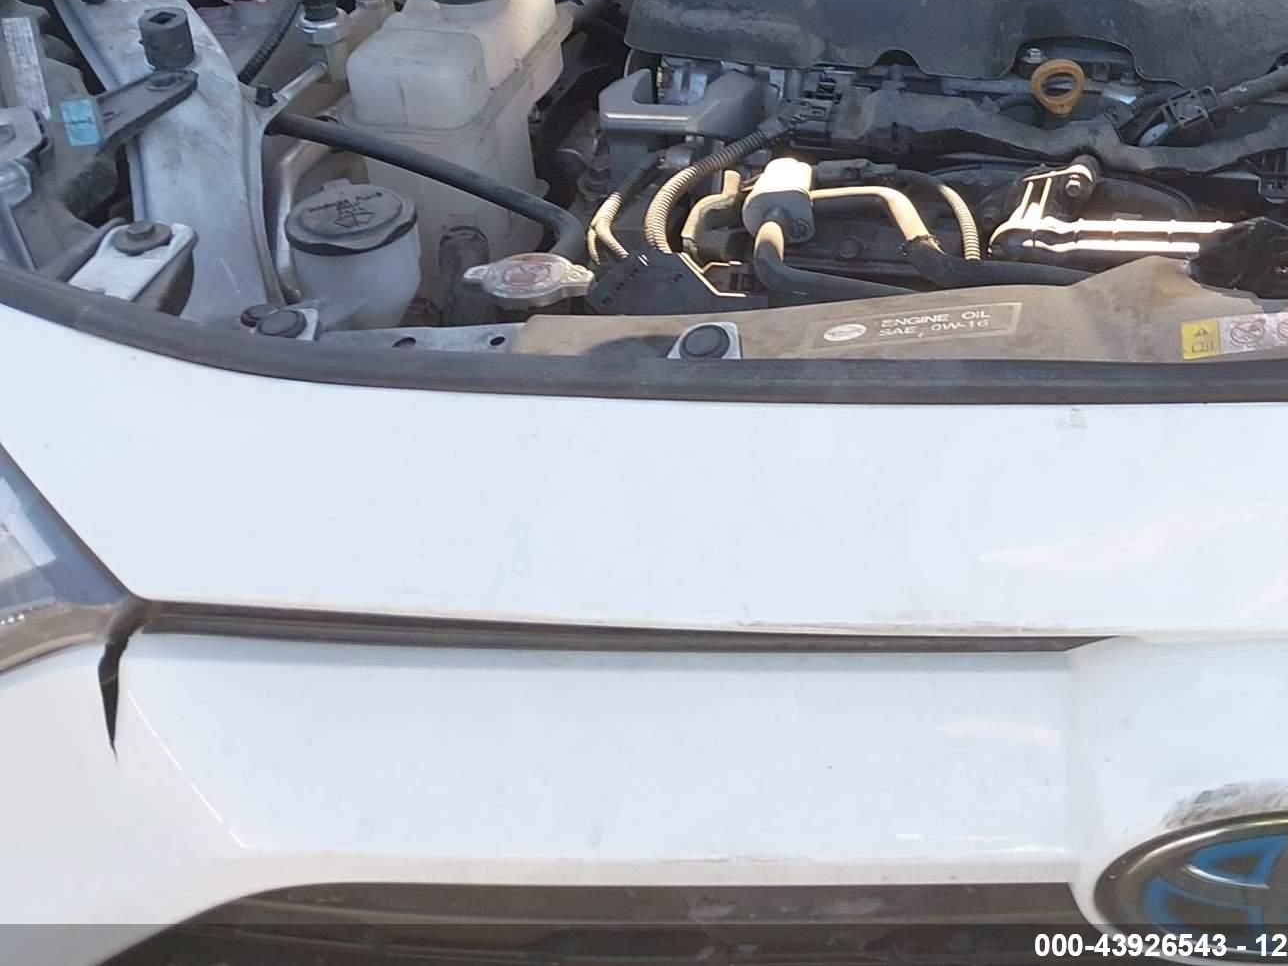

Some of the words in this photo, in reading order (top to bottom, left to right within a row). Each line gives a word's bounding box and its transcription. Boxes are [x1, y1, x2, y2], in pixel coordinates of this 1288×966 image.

[881, 313, 950, 328] ENGINE
[961, 310, 991, 320] OIL
[931, 319, 988, 331] 0W-16
